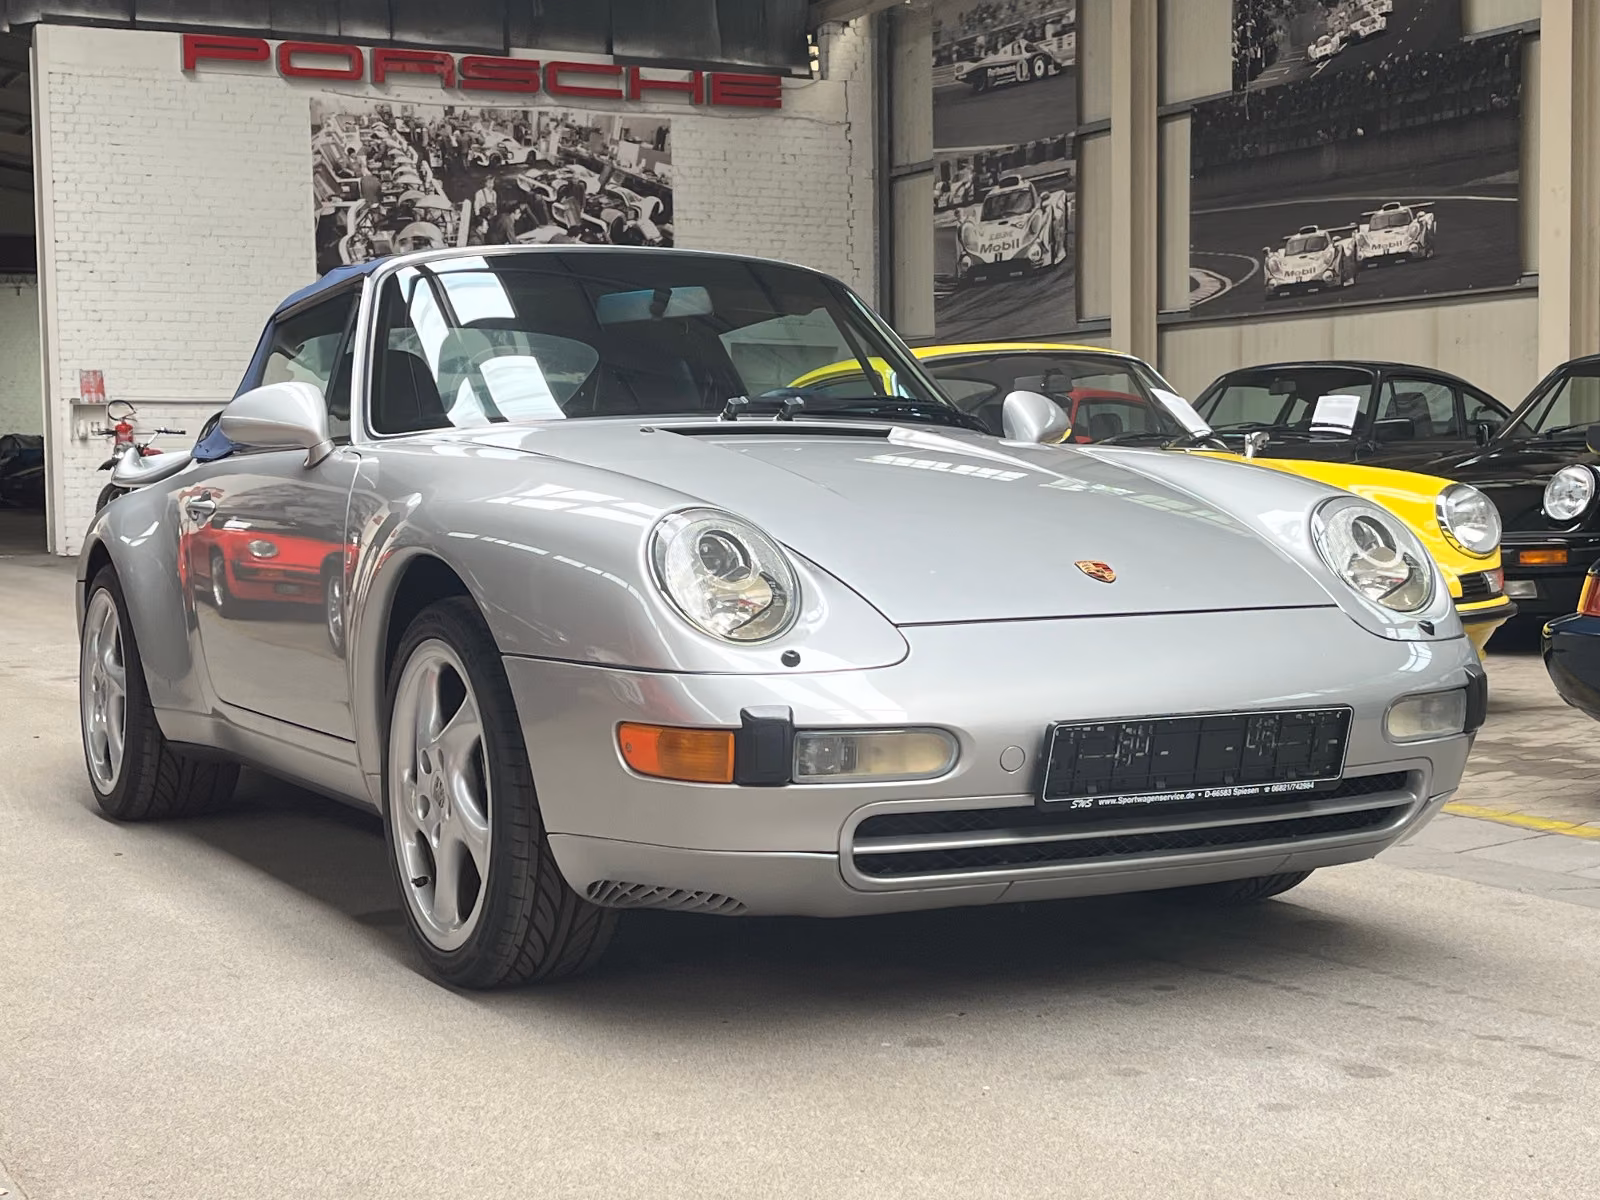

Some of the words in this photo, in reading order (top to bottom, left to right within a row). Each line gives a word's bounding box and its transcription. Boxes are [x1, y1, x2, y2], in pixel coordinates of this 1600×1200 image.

[181, 33, 782, 109] PORSCHE
[980, 238, 1020, 254] Mobil
[1370, 240, 1403, 251] Mobil
[1284, 266, 1316, 278] Mobil
[1098, 792, 1195, 805] www.Sportwagenservice.de
[1233, 787, 1260, 797] Spiesen
